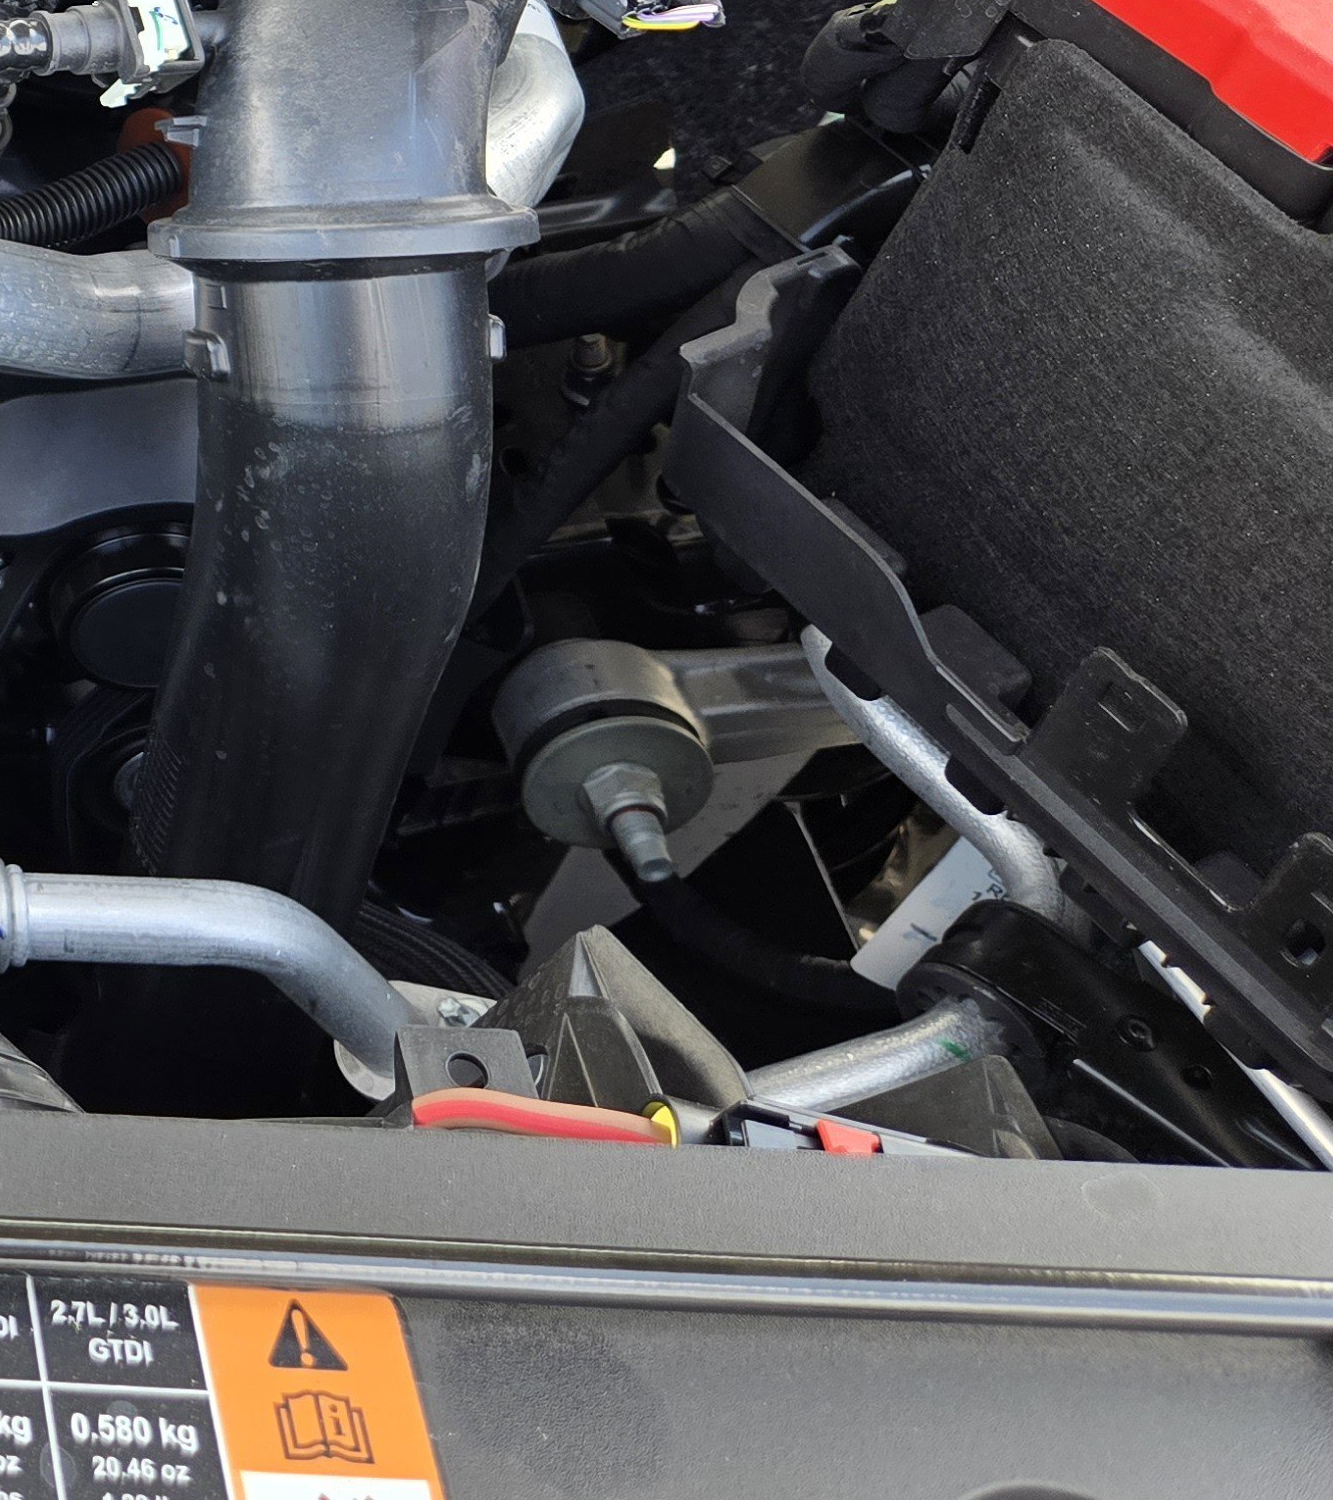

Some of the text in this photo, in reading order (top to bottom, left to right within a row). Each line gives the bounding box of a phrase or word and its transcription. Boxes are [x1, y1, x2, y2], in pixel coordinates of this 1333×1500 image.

[50, 1299, 107, 1327] 2.7L
[122, 1303, 180, 1332] 3.0L
[88, 1336, 155, 1367] GTDI
[70, 1412, 200, 1457] 0.580 kg
[91, 1455, 193, 1487] 20.46 oz
